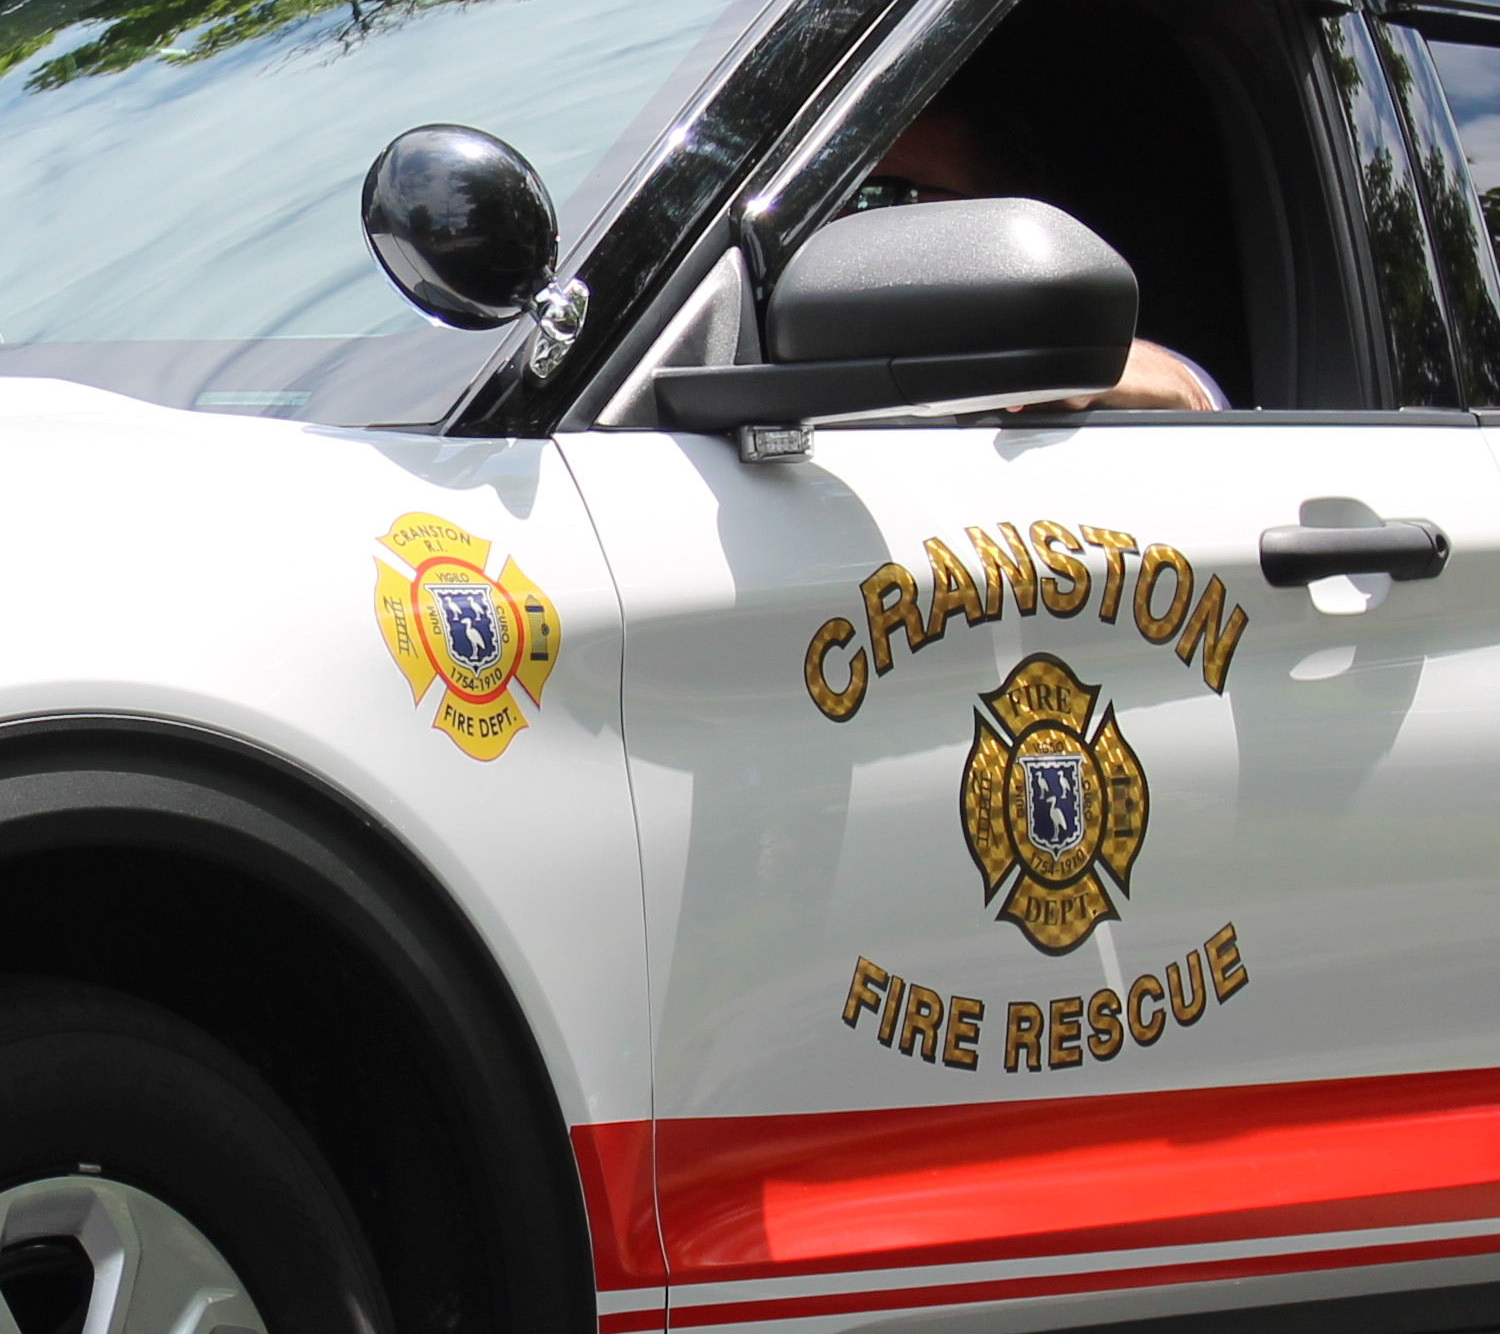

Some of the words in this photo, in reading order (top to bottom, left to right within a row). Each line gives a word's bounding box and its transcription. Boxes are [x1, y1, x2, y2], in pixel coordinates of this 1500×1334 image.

[393, 525, 471, 547] CRANSTON
[427, 540, 448, 553] R.I.
[436, 572, 470, 583] VIGILO
[427, 606, 442, 635] DUM
[496, 605, 510, 644] CURO
[804, 519, 1249, 723] CRANSTON
[451, 667, 503, 691] 1754-1910
[1006, 683, 1072, 718] FIRE
[444, 704, 474, 737] FIRE
[479, 707, 517, 738] DEPT.
[1031, 849, 1085, 876] 1754-1910
[1025, 892, 1099, 926] DEPT.
[841, 955, 988, 1071] FIRE
[1004, 921, 1250, 1073] RESCUE
